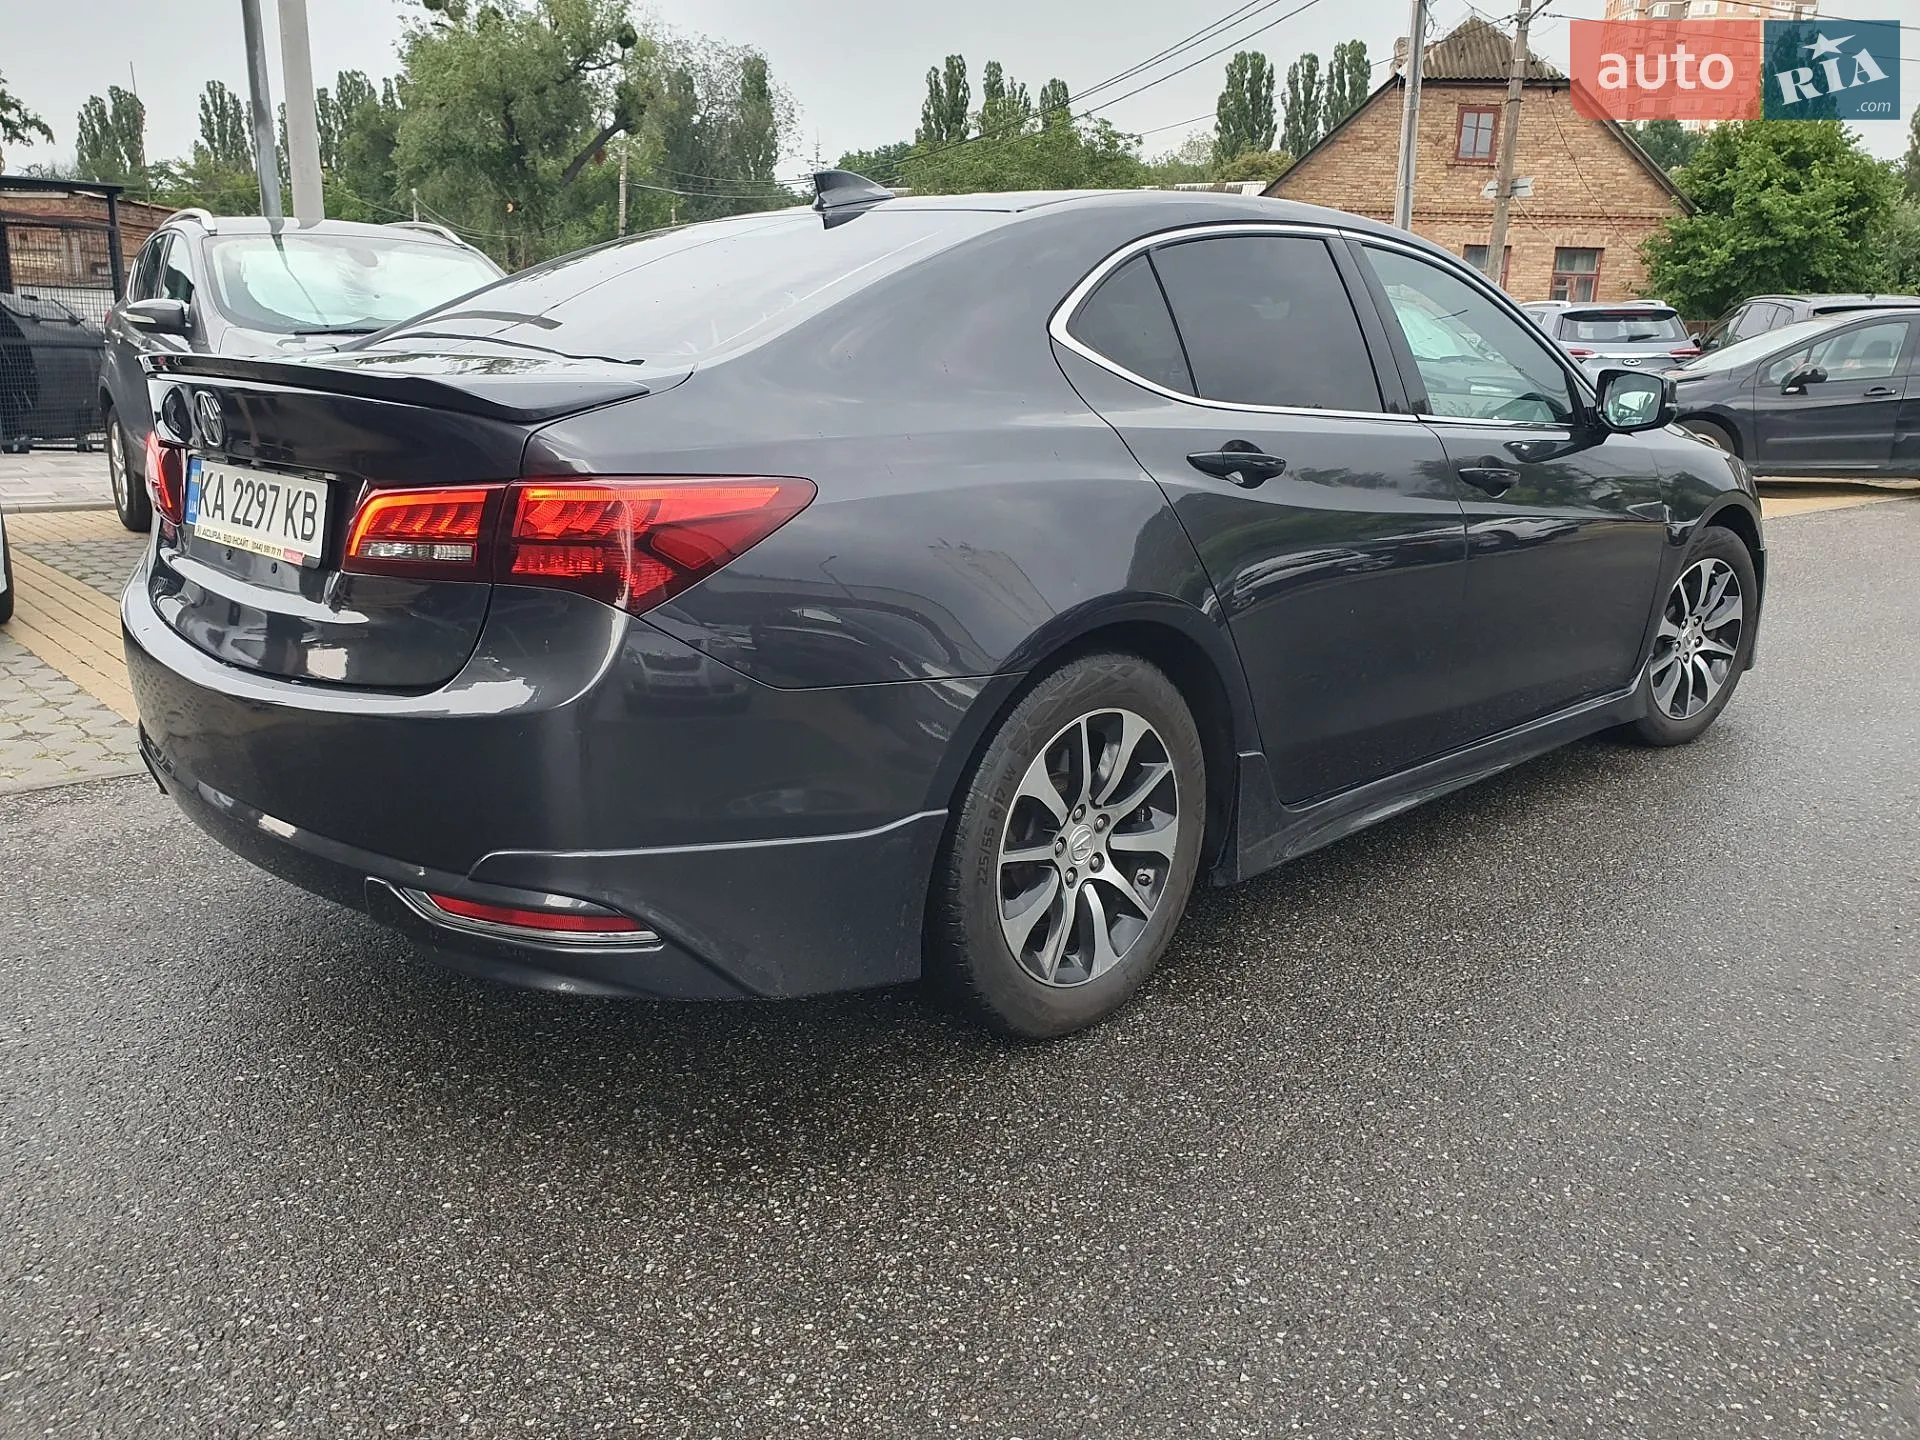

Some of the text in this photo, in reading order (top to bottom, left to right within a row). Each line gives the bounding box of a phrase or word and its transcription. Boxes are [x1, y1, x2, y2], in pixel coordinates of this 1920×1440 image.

[198, 471, 318, 542] KA 2297 KB
[976, 825, 995, 885] 225/55
